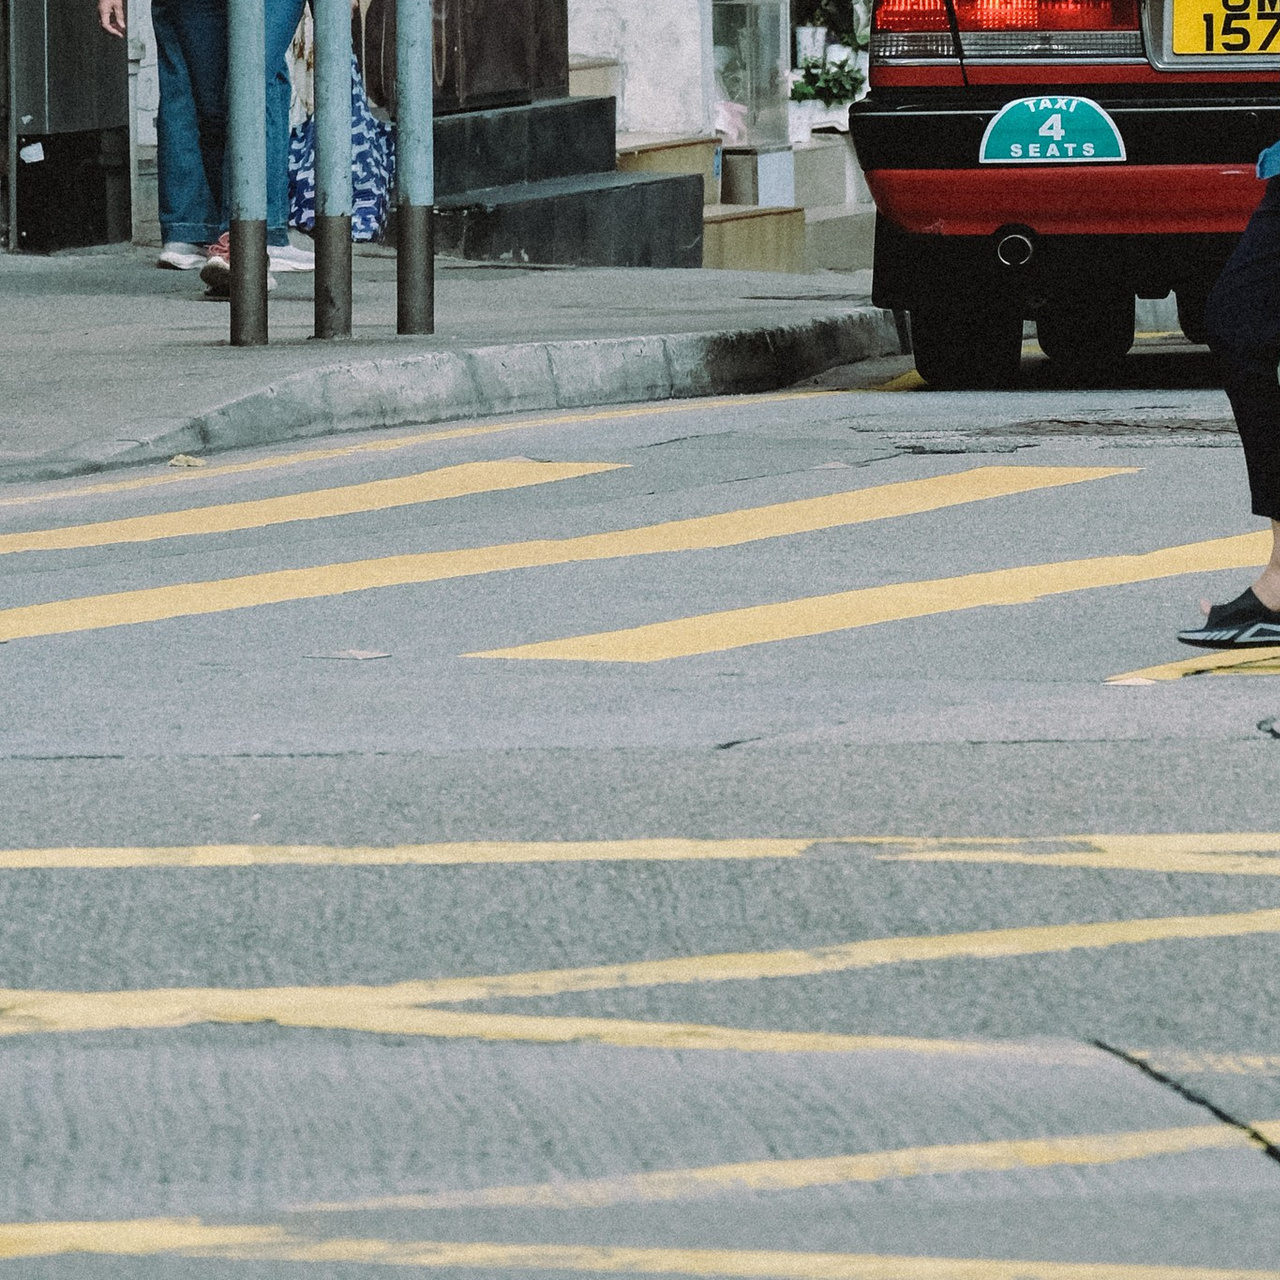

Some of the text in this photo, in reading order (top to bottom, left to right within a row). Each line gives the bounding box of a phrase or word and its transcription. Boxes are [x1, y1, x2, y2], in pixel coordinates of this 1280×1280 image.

[1023, 98, 1079, 114] TAXI
[1038, 113, 1065, 141] 4
[1010, 143, 1095, 158] SEATS
